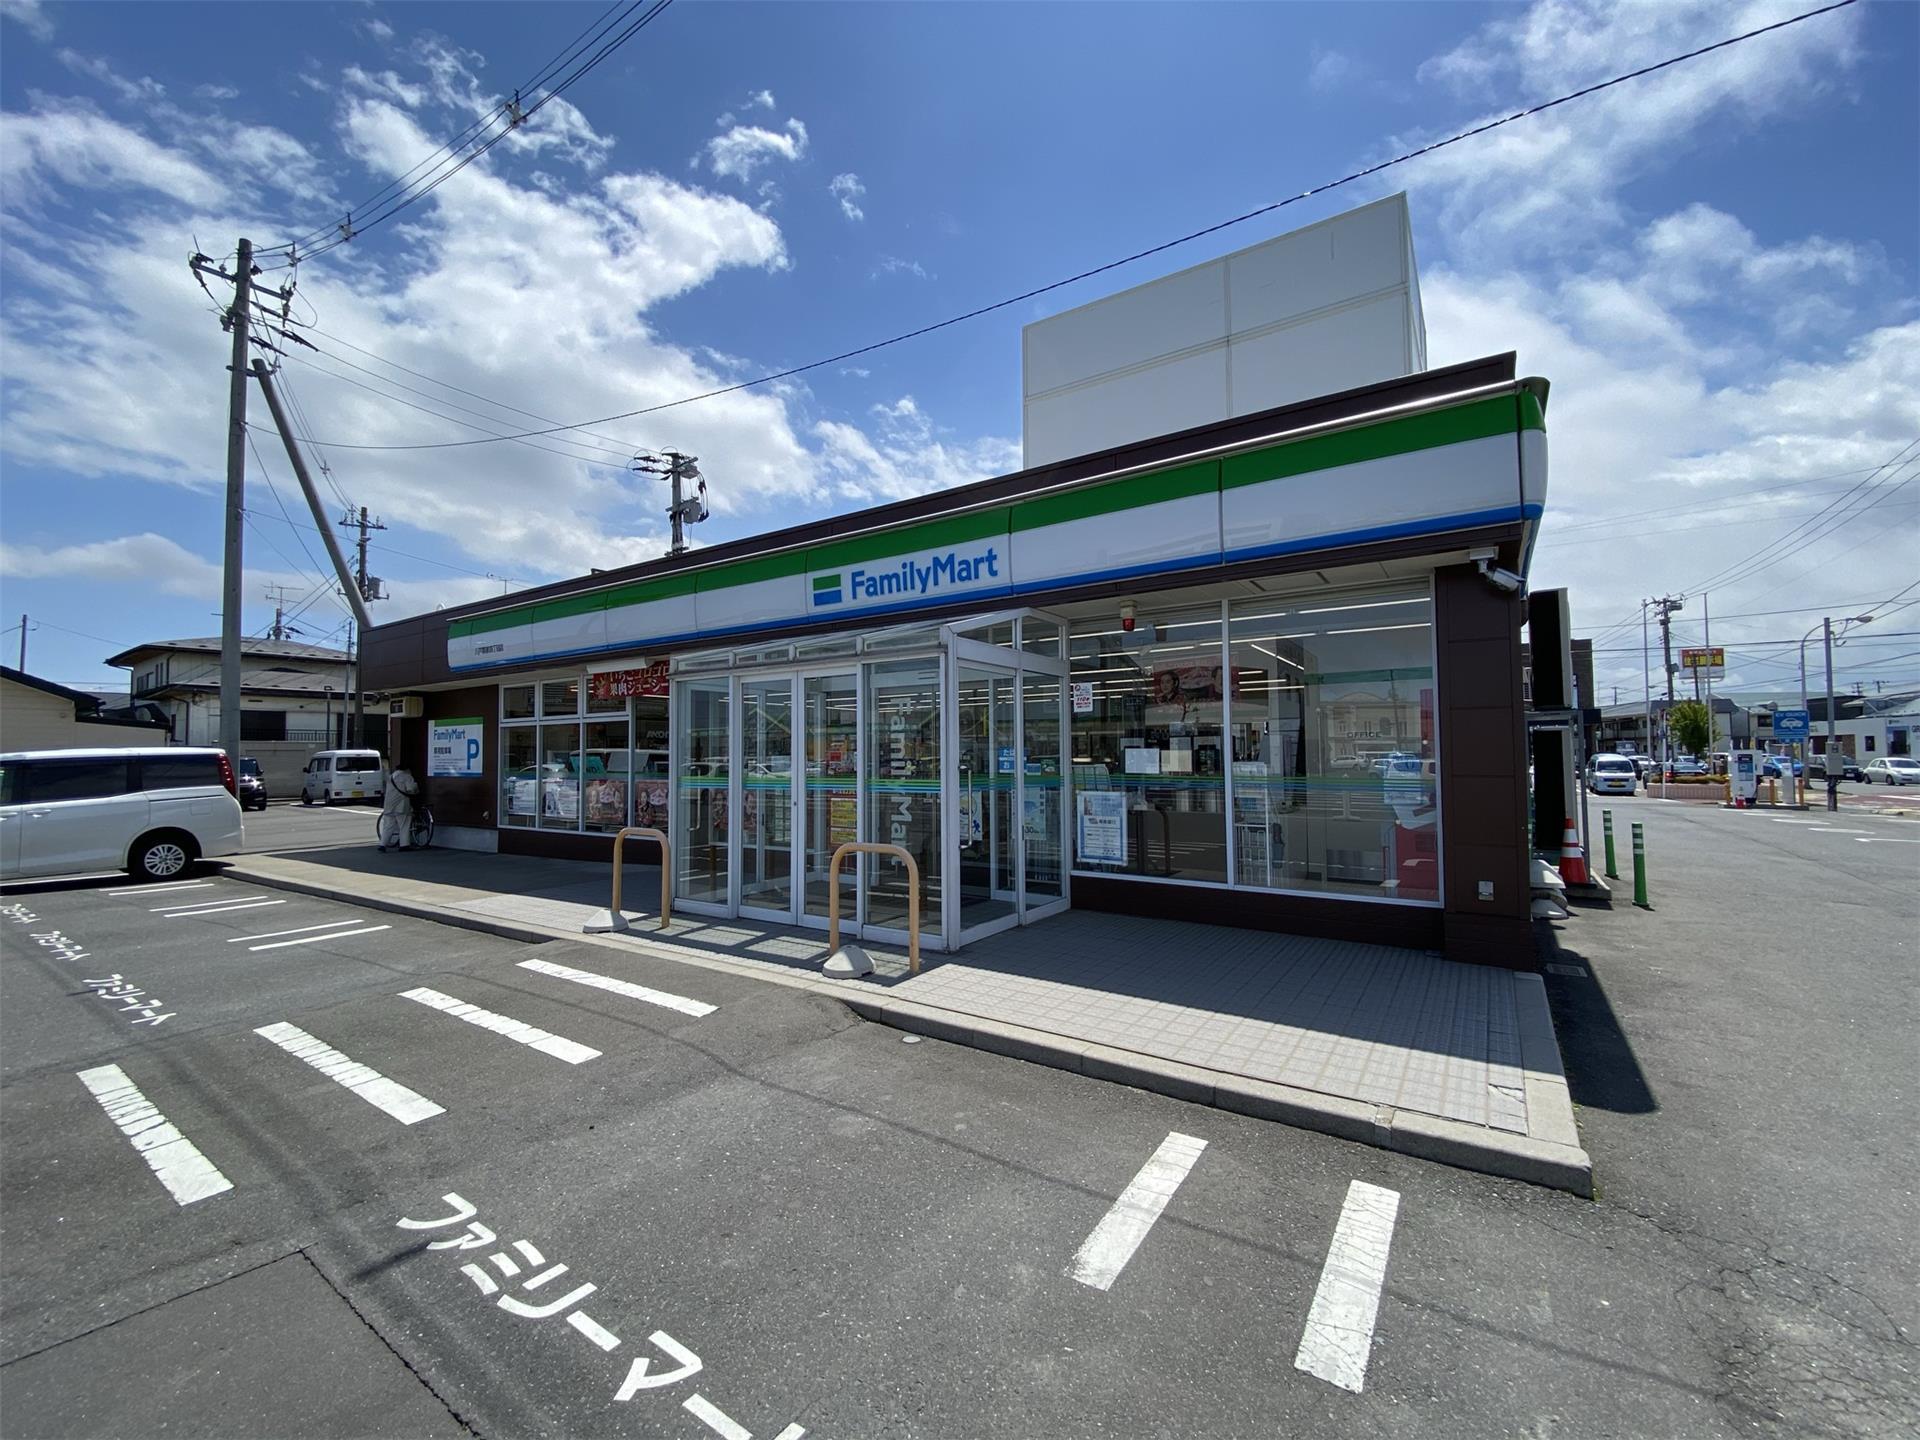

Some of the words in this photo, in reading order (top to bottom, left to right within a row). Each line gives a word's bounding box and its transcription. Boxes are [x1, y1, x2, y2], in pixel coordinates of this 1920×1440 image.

[851, 547, 998, 600] FamilyMart
[434, 728, 466, 743] FamilyMart
[467, 738, 480, 770] P
[890, 697, 912, 867] FamilMar
[82, 973, 177, 1026] ファミリーマート
